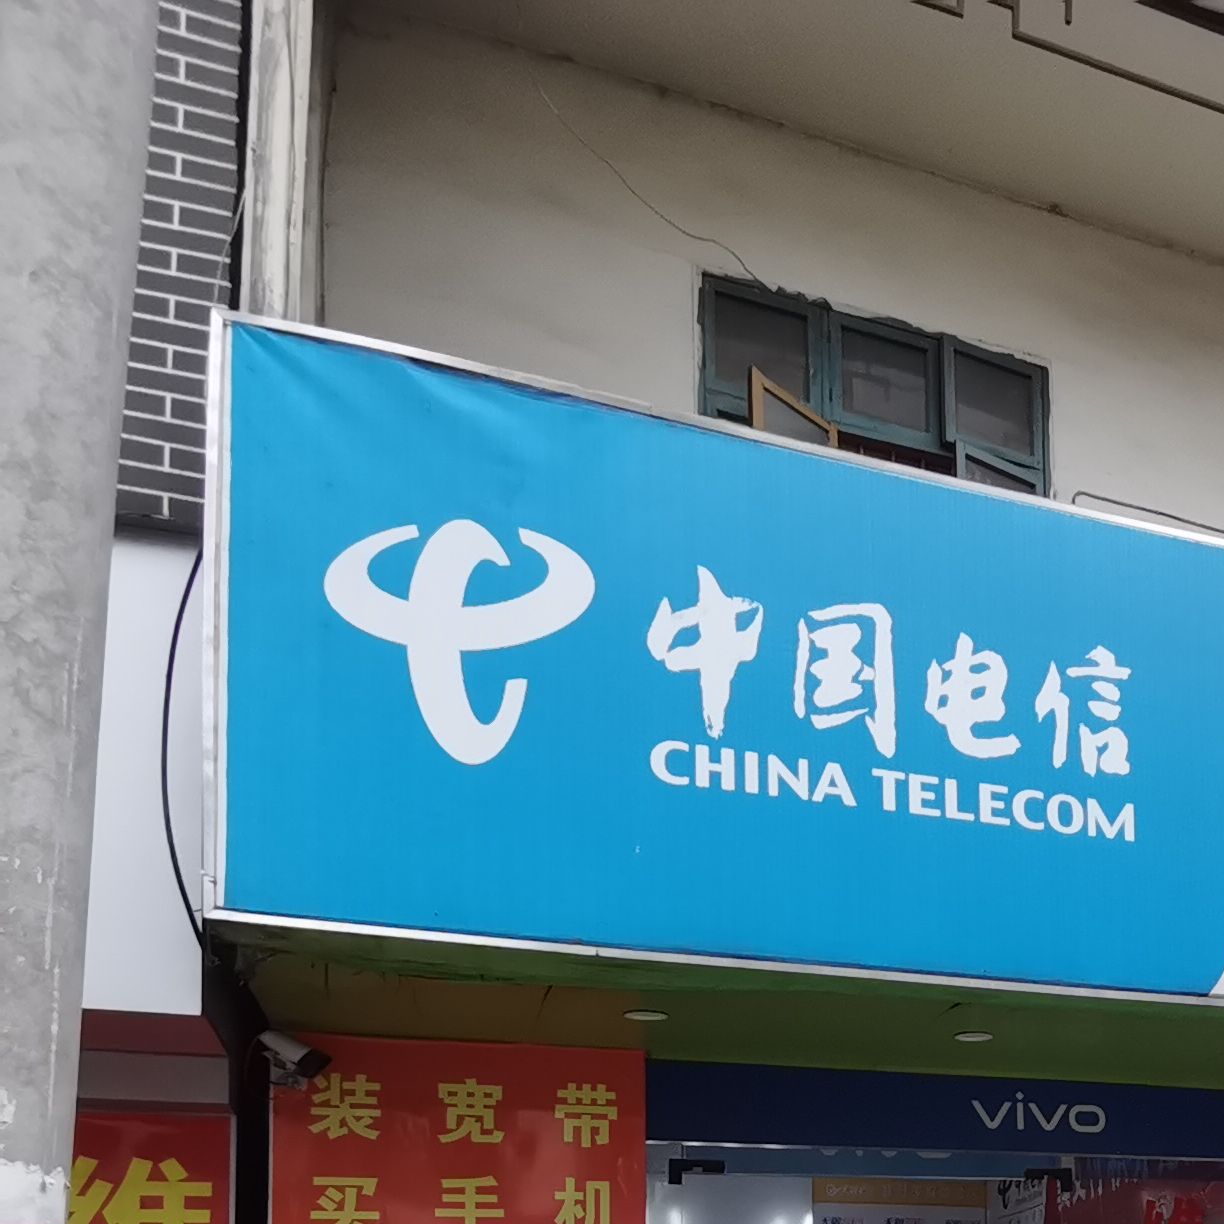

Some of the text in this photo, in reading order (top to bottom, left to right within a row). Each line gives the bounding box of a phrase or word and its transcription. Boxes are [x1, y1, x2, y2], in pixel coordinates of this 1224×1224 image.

[647, 565, 1131, 777] 中国电信
[650, 740, 1135, 842] CHINA TELECOM
[308, 1075, 619, 1147] 装宽带
[971, 1092, 1106, 1134] vivo
